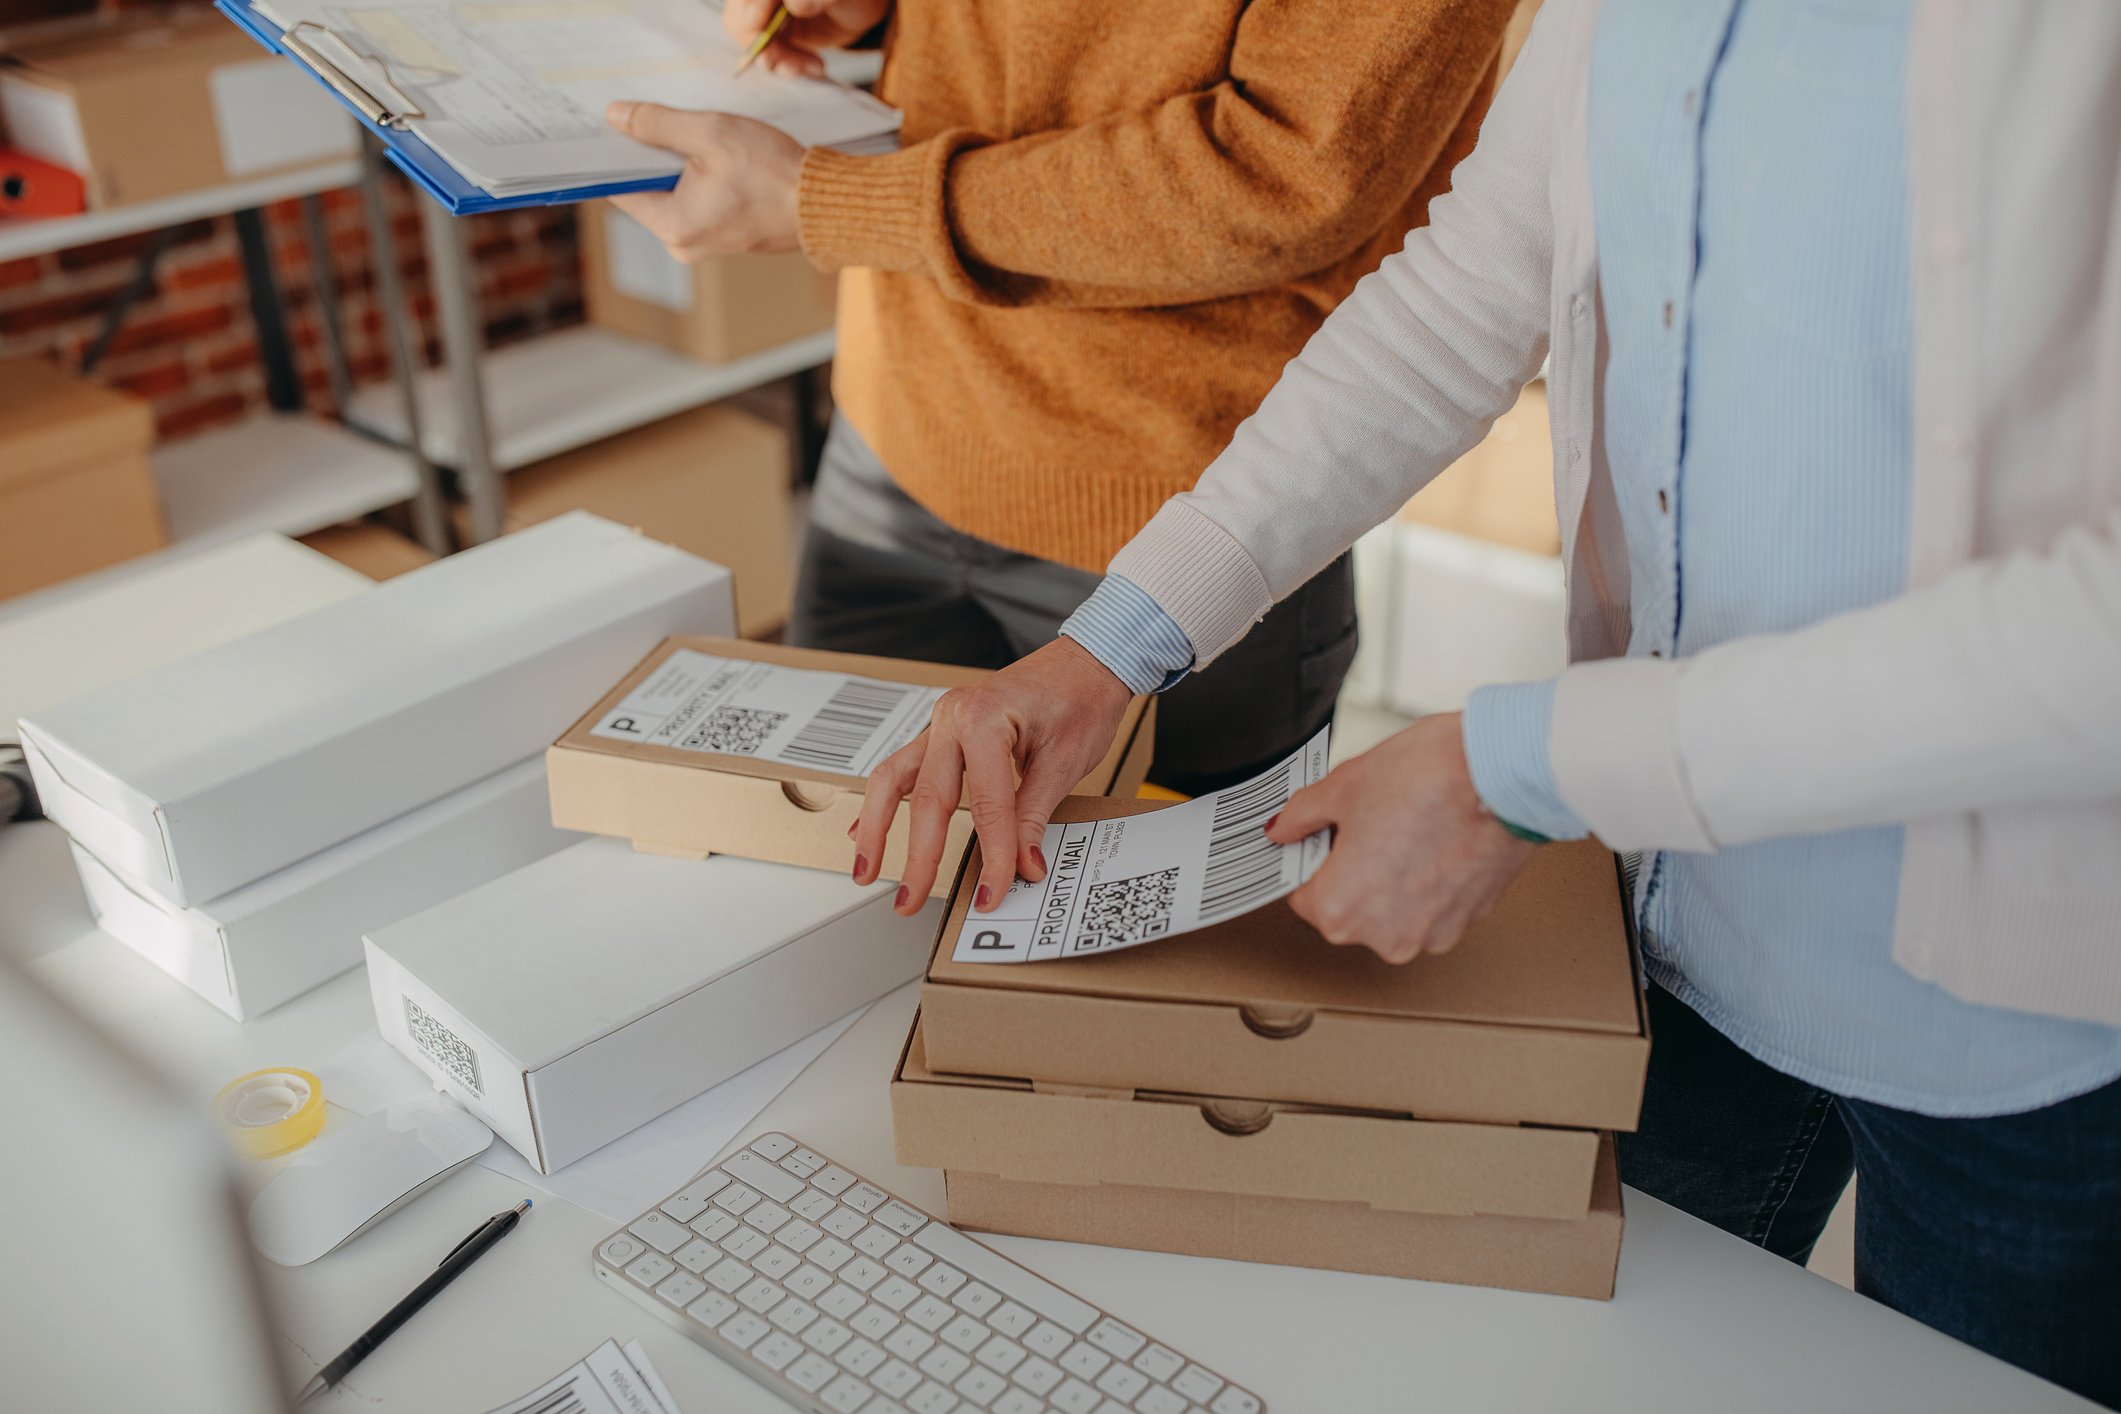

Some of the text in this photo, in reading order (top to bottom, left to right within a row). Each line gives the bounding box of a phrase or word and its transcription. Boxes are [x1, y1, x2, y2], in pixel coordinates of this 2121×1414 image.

[1104, 823, 1114, 831] ST
[1101, 830, 1112, 845] MAIN
[1038, 835, 1088, 947] PRIORITY MAIL
[971, 929, 1015, 951] P
[862, 1186, 882, 1199] option
[891, 1202, 922, 1221] command
